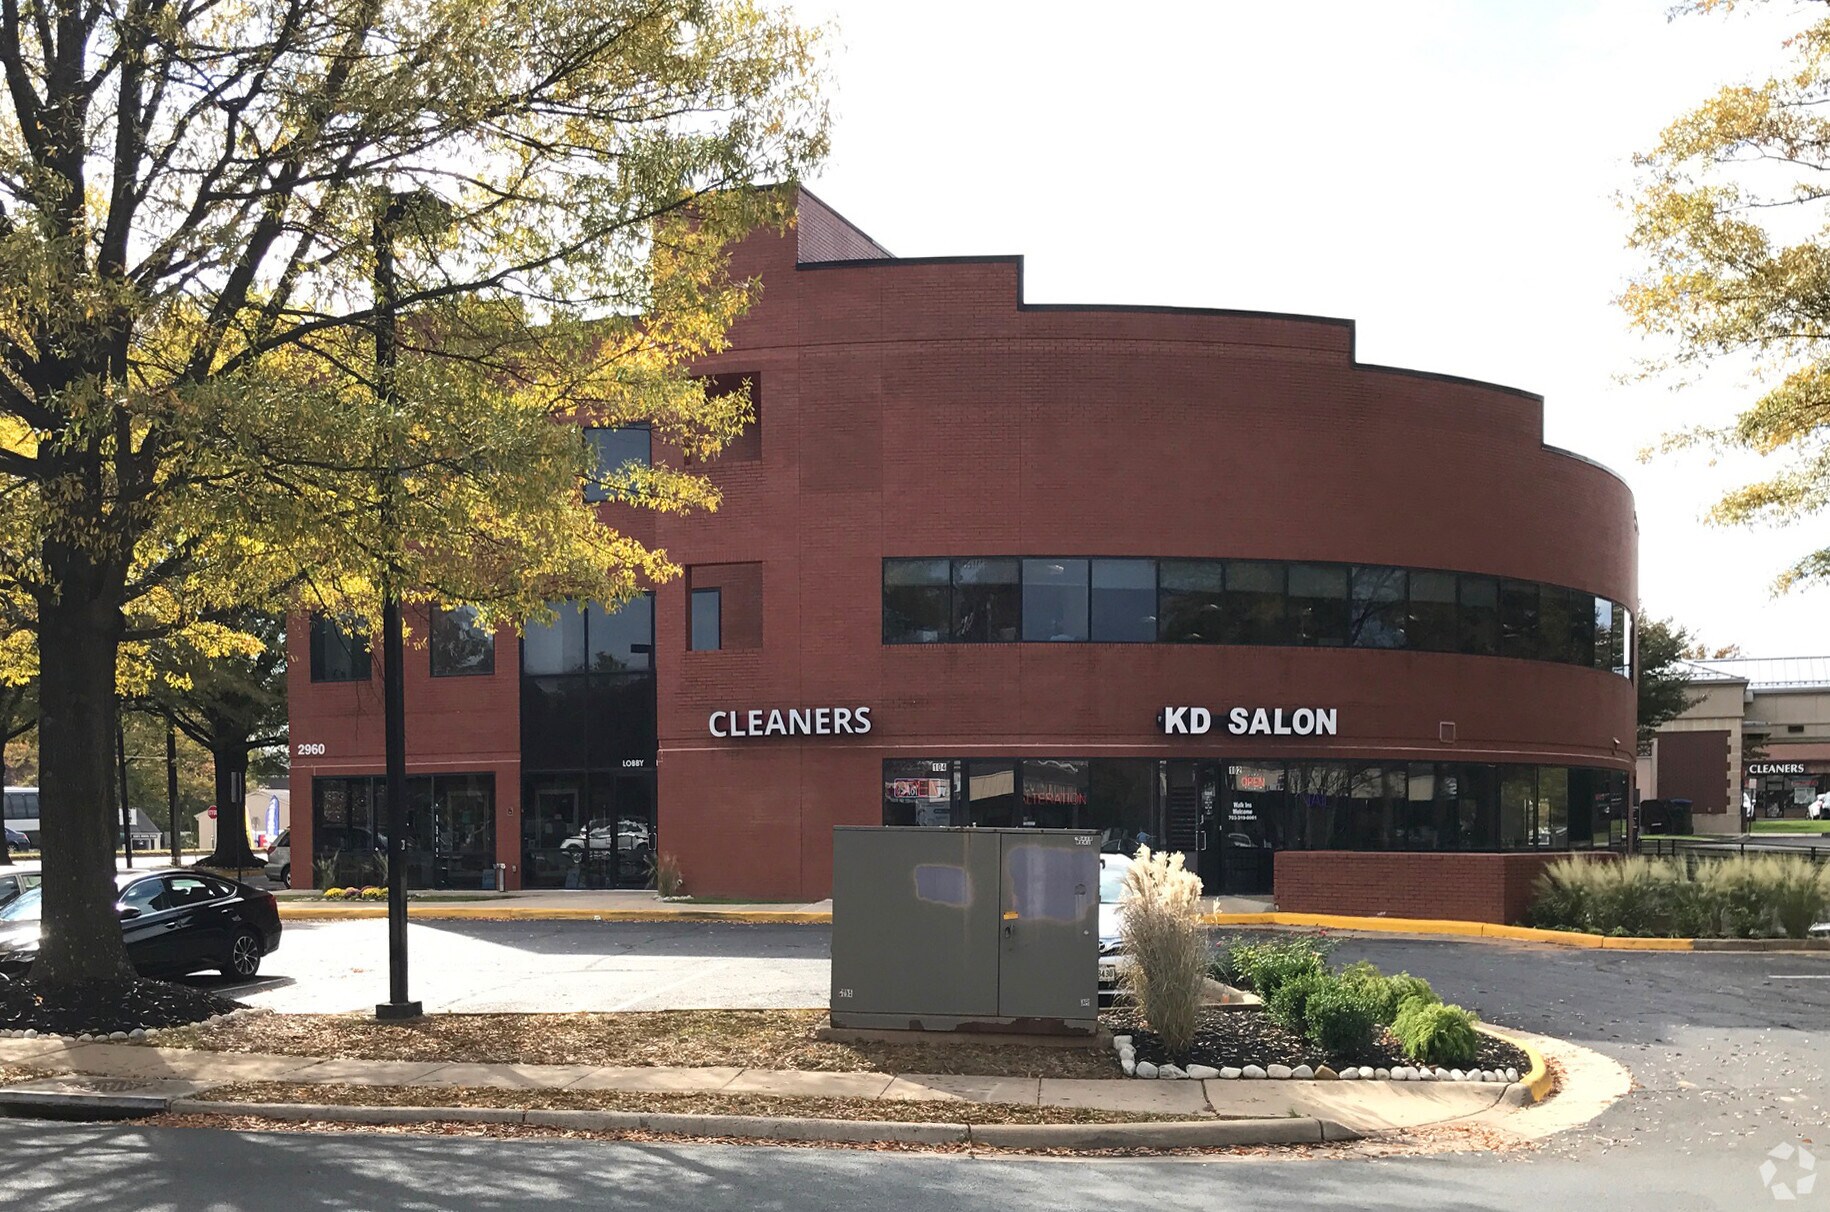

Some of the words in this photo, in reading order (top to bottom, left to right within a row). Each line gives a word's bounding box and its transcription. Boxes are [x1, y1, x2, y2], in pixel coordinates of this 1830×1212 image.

[708, 706, 872, 738] CLEANERS
[1164, 706, 1211, 735] KD
[1228, 707, 1337, 736] SALON
[297, 743, 326, 756] 2960
[622, 759, 645, 768] LOBBY
[932, 762, 947, 772] 104
[1749, 763, 1805, 774] CLEANERS
[1241, 776, 1265, 788] OPEN
